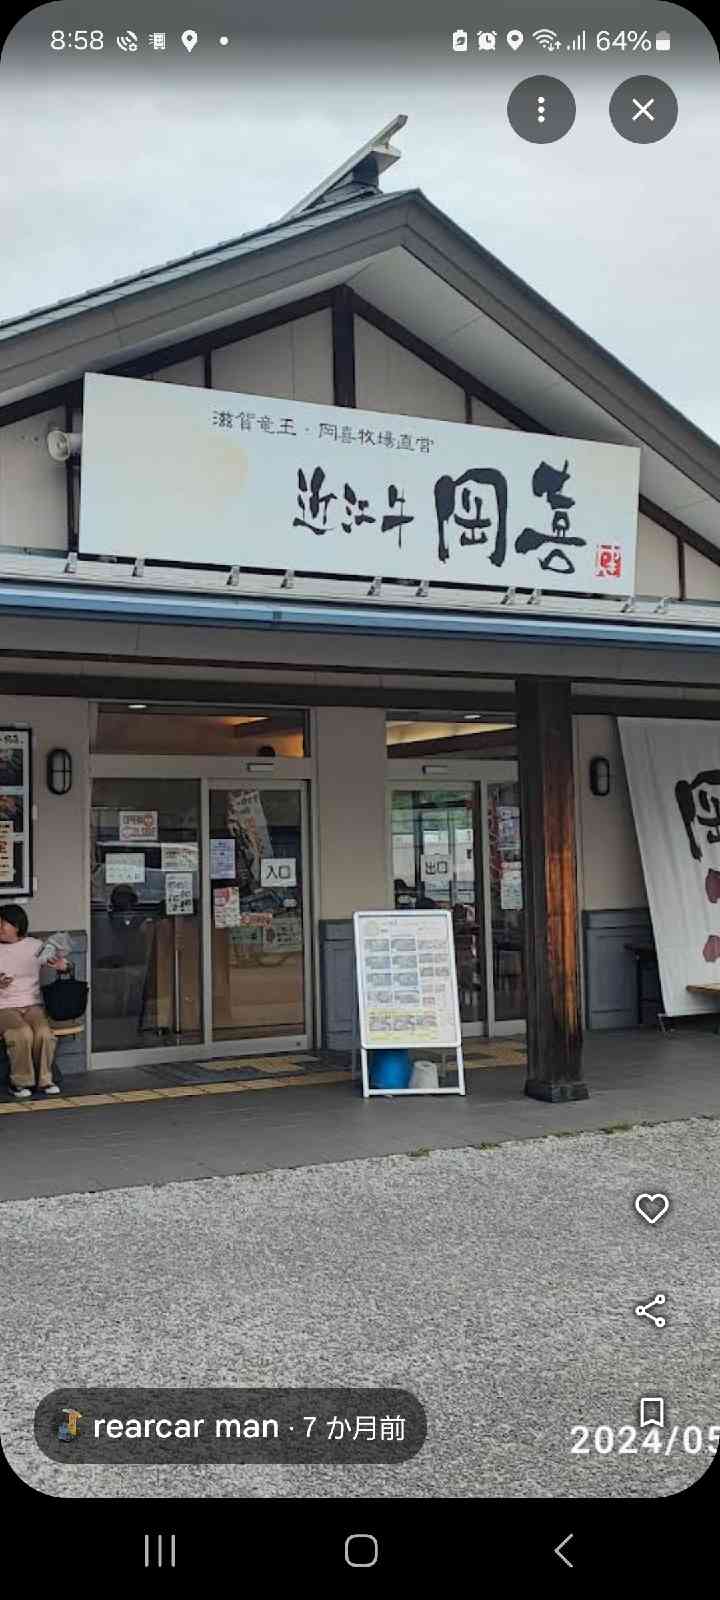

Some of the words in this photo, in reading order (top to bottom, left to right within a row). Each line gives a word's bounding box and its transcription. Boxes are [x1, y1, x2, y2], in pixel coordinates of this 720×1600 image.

[293, 466, 414, 549] 近江牛
[434, 459, 587, 574] 岡喜
[266, 865, 291, 879] 入口
